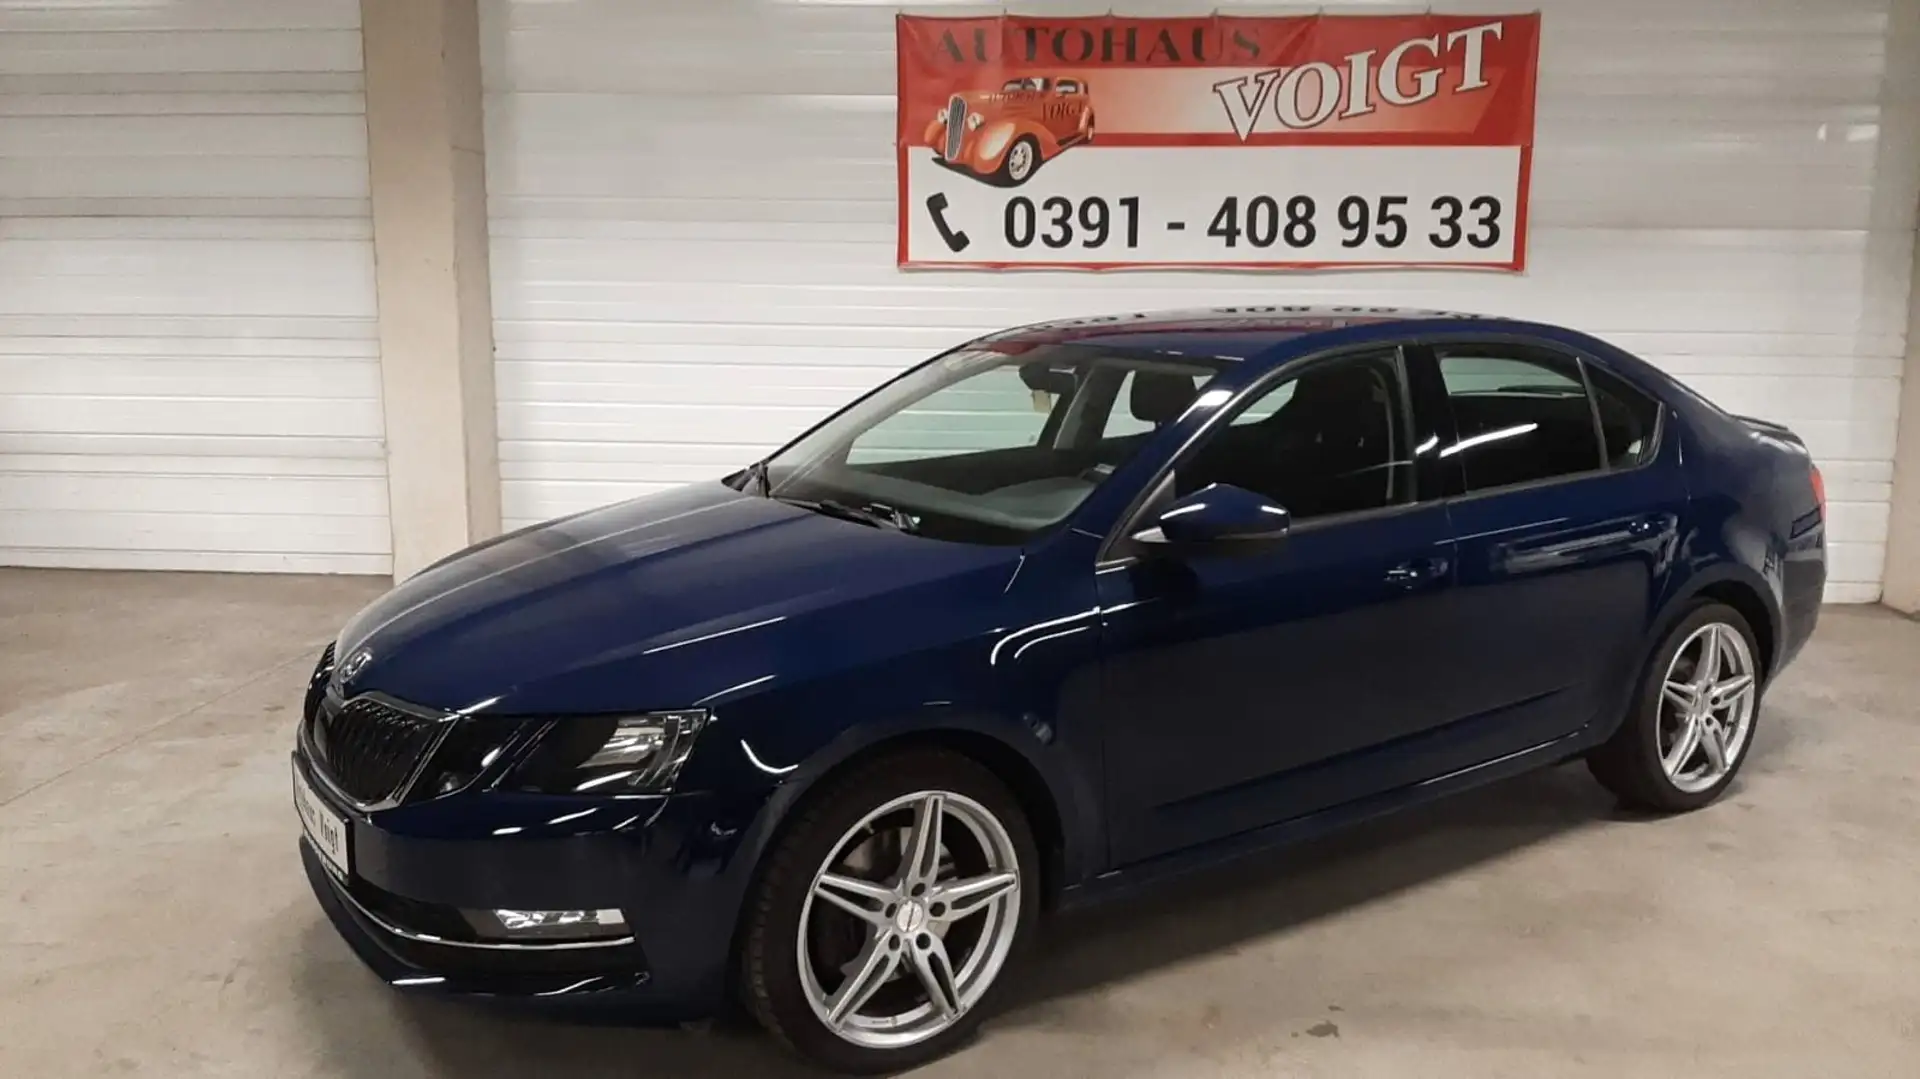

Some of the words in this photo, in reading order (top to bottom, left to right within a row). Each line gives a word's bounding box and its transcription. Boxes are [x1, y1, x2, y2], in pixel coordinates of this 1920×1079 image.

[936, 27, 1262, 63] AUTOHAUS
[1213, 21, 1504, 142] VOIGT
[1004, 195, 1139, 249] 0391
[1207, 195, 1317, 248] 408
[1337, 195, 1408, 249] 95
[1428, 195, 1501, 249] 33
